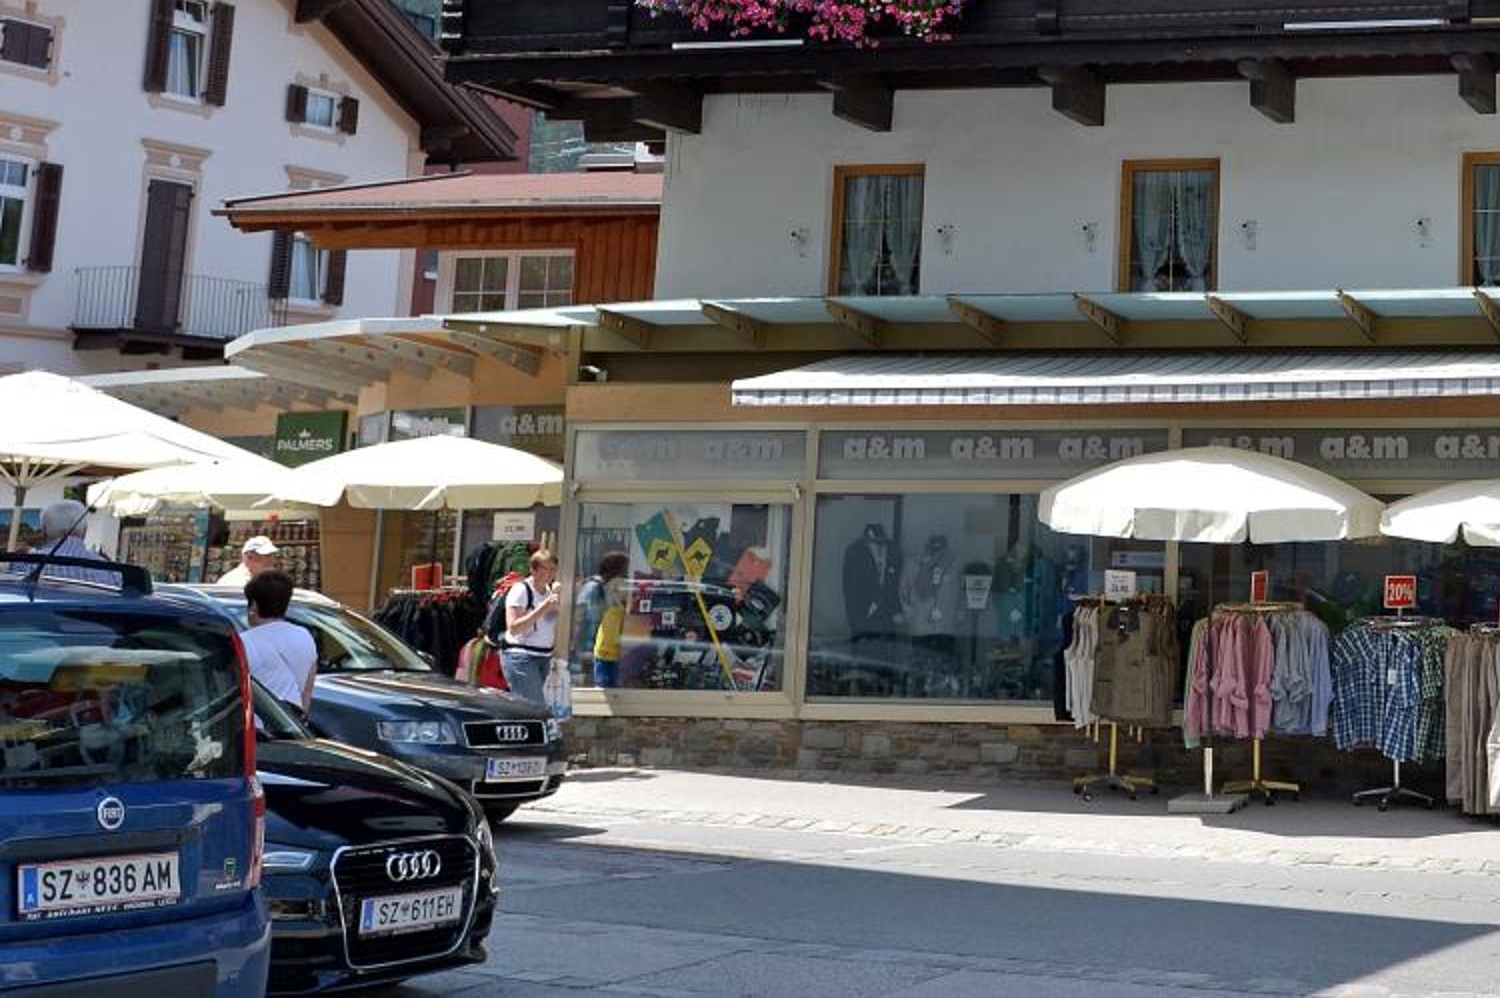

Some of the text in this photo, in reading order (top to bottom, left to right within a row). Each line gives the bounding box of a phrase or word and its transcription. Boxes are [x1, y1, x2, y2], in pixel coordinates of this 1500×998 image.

[277, 438, 333, 452] PALMERS
[843, 435, 1143, 459] a&m a&m a&m
[1320, 435, 1408, 459] a&m
[1388, 583, 1413, 601] 20%
[103, 807, 122, 819] FIAT
[42, 861, 171, 902] SZ 836 AM
[379, 895, 455, 925] SZ 611EH
